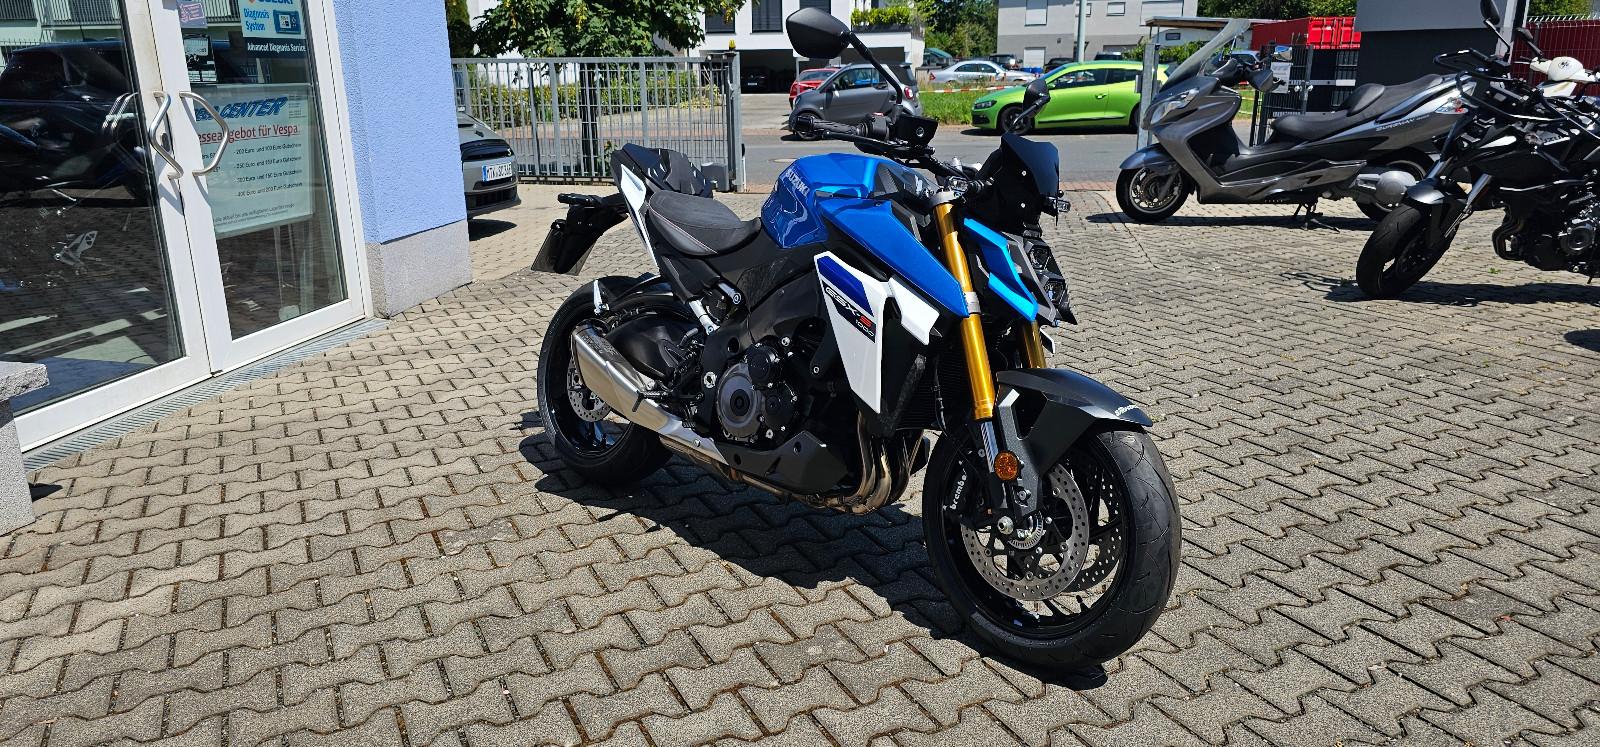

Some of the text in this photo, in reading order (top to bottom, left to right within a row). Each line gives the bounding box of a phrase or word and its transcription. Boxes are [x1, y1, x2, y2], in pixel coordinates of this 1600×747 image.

[243, 8, 270, 20] Diagnosis
[245, 20, 266, 32] System
[247, 42, 307, 54] Advanced Diagnosis Service
[220, 96, 289, 119] CENTER
[258, 125, 272, 137] für
[273, 124, 299, 138] Vespa
[855, 319, 875, 337] 1000
[950, 474, 967, 509] brembo
